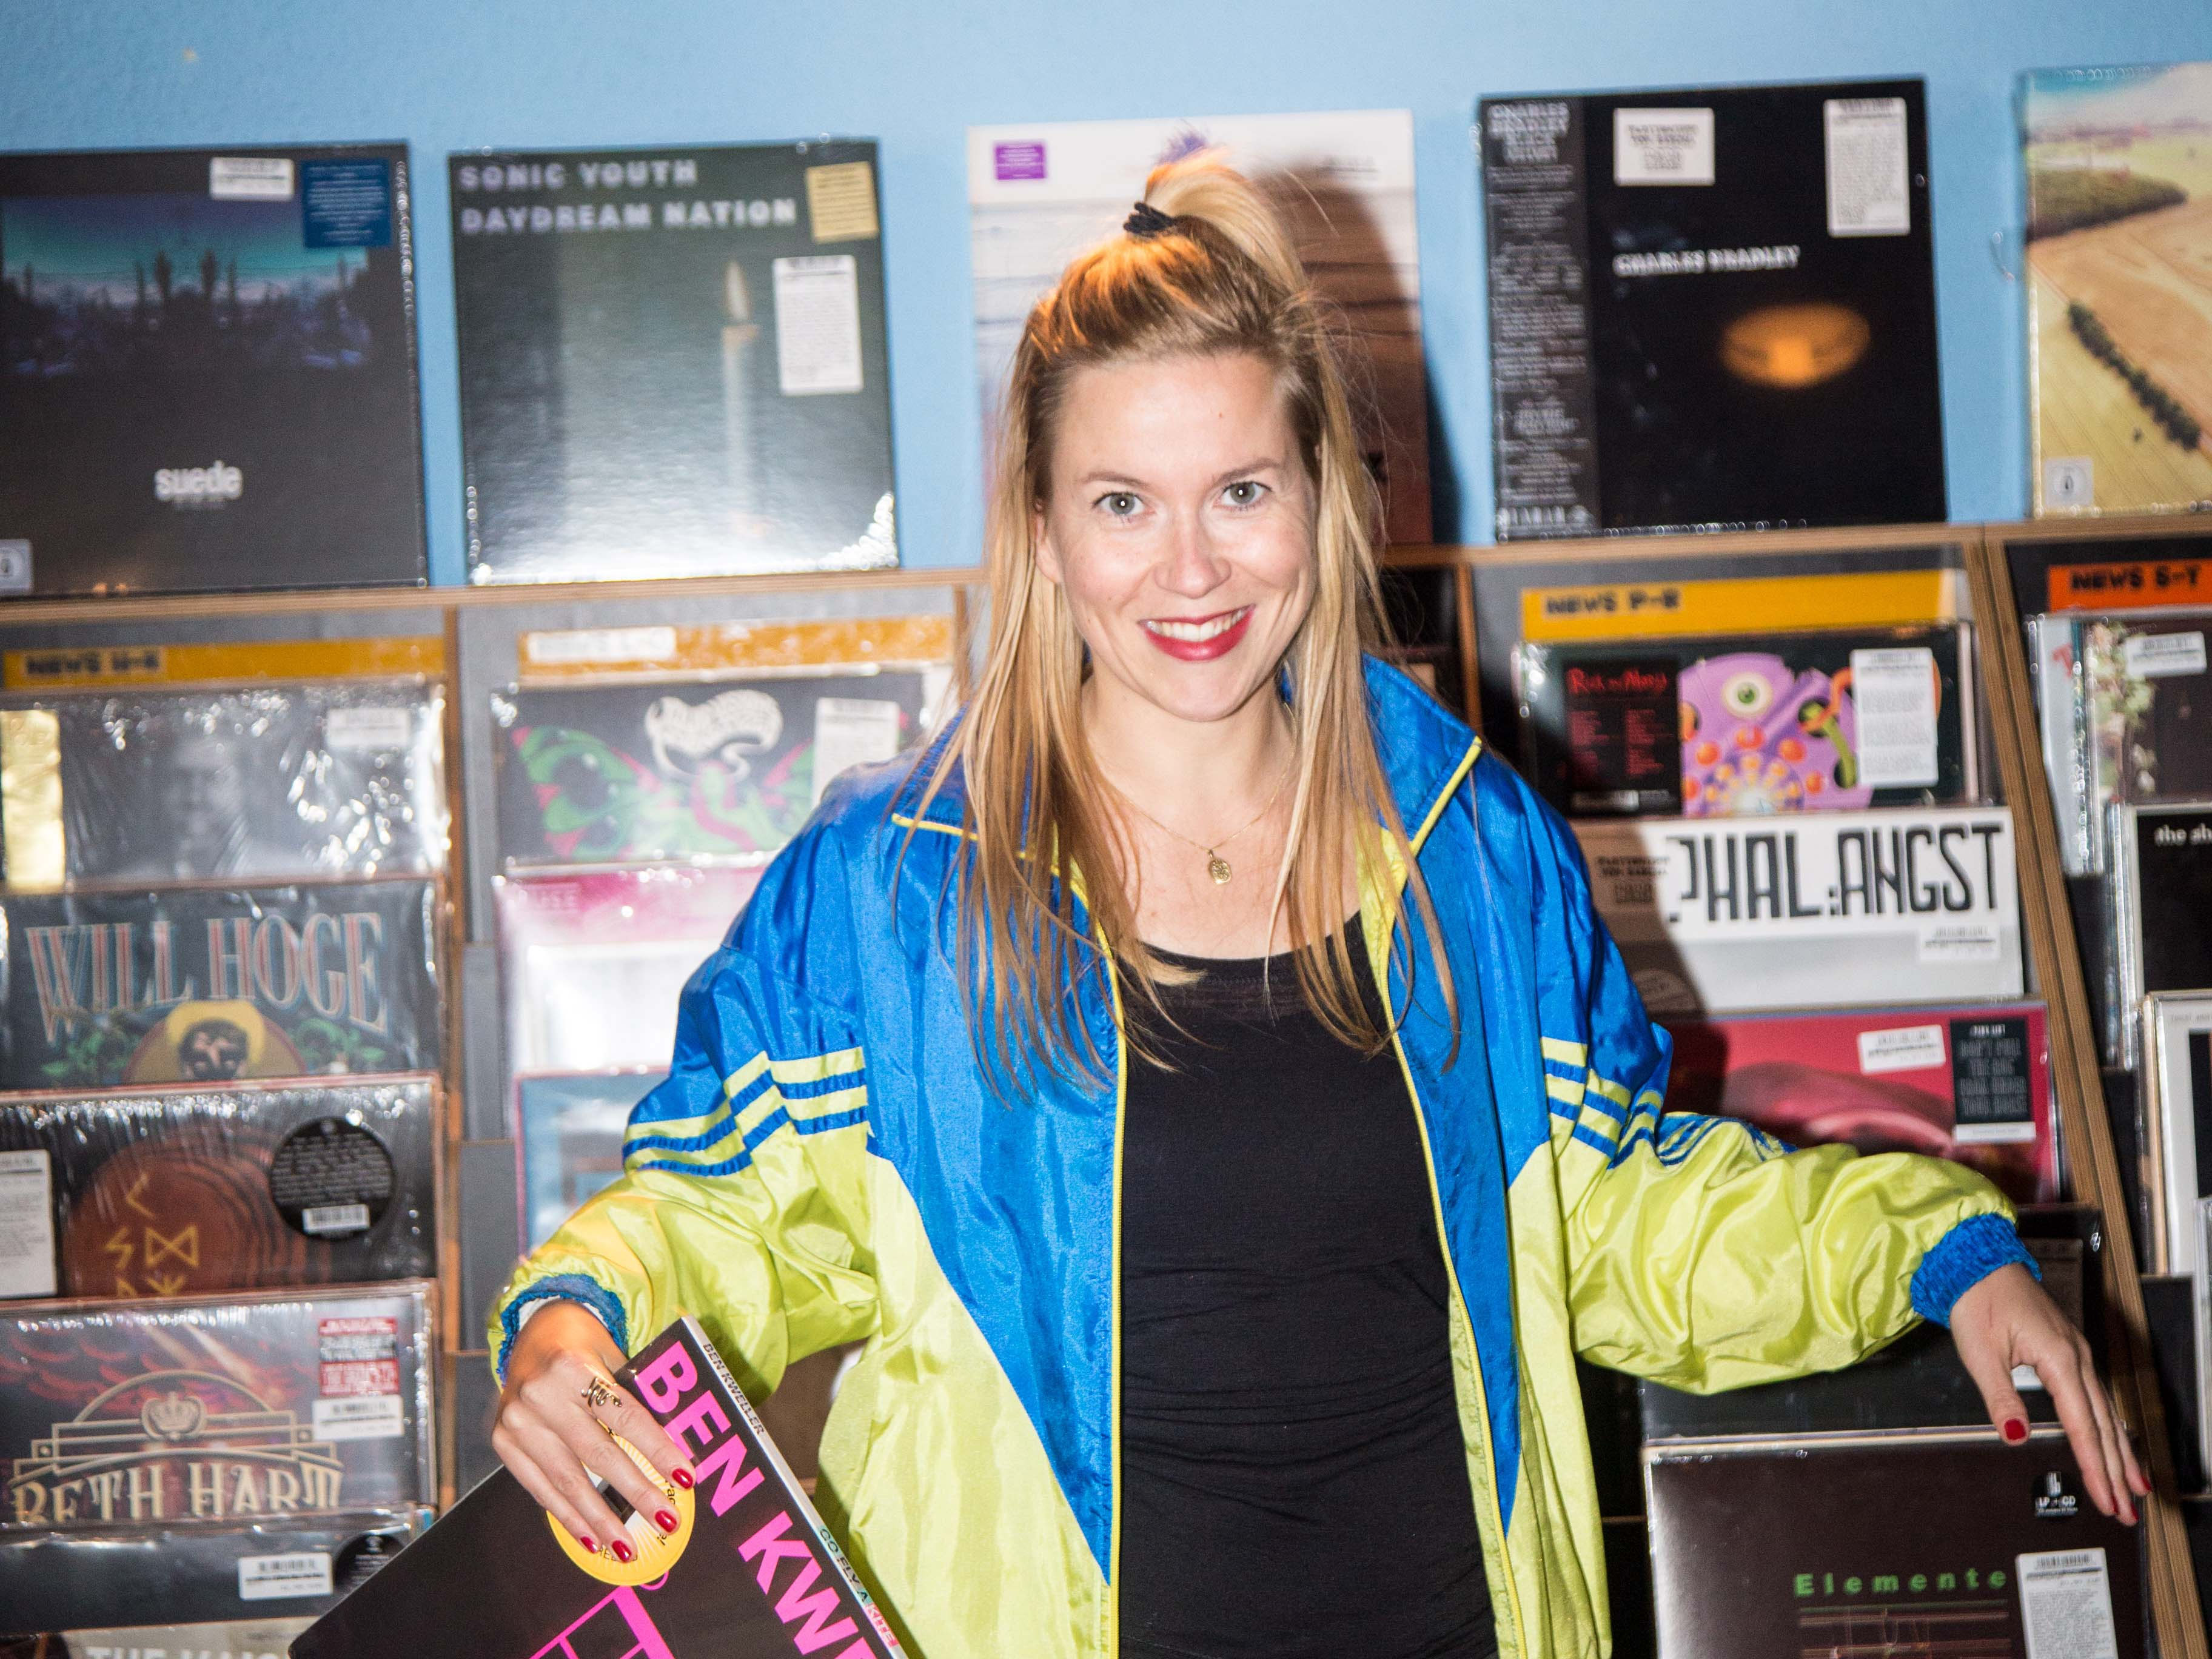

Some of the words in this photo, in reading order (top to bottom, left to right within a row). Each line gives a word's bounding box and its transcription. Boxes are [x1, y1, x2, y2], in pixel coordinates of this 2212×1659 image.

[459, 161, 565, 192] SONIC
[577, 159, 698, 189] YOUTH
[461, 202, 652, 234] DAYDREAM
[663, 198, 796, 229] NATION
[1612, 250, 1706, 277] CHARLES
[155, 460, 242, 500] suede
[2072, 565, 2143, 592] NEWS
[1547, 591, 1617, 614] NEWS
[2154, 824, 2188, 846] the
[24, 920, 197, 1047] WILL
[206, 911, 390, 1034] HOGE
[703, 1343, 726, 1370] BEN
[722, 1373, 765, 1435] KWELLER
[634, 1341, 765, 1517] BEN
[10, 1464, 166, 1524] BETH
[188, 1461, 343, 1517] HART
[2059, 1495, 2076, 1507] CD
[820, 1529, 839, 1553] GO
[837, 1557, 860, 1584] FLY
[857, 1590, 868, 1602] A
[867, 1606, 897, 1646] KITE
[1794, 1567, 2006, 1598] Elemente
